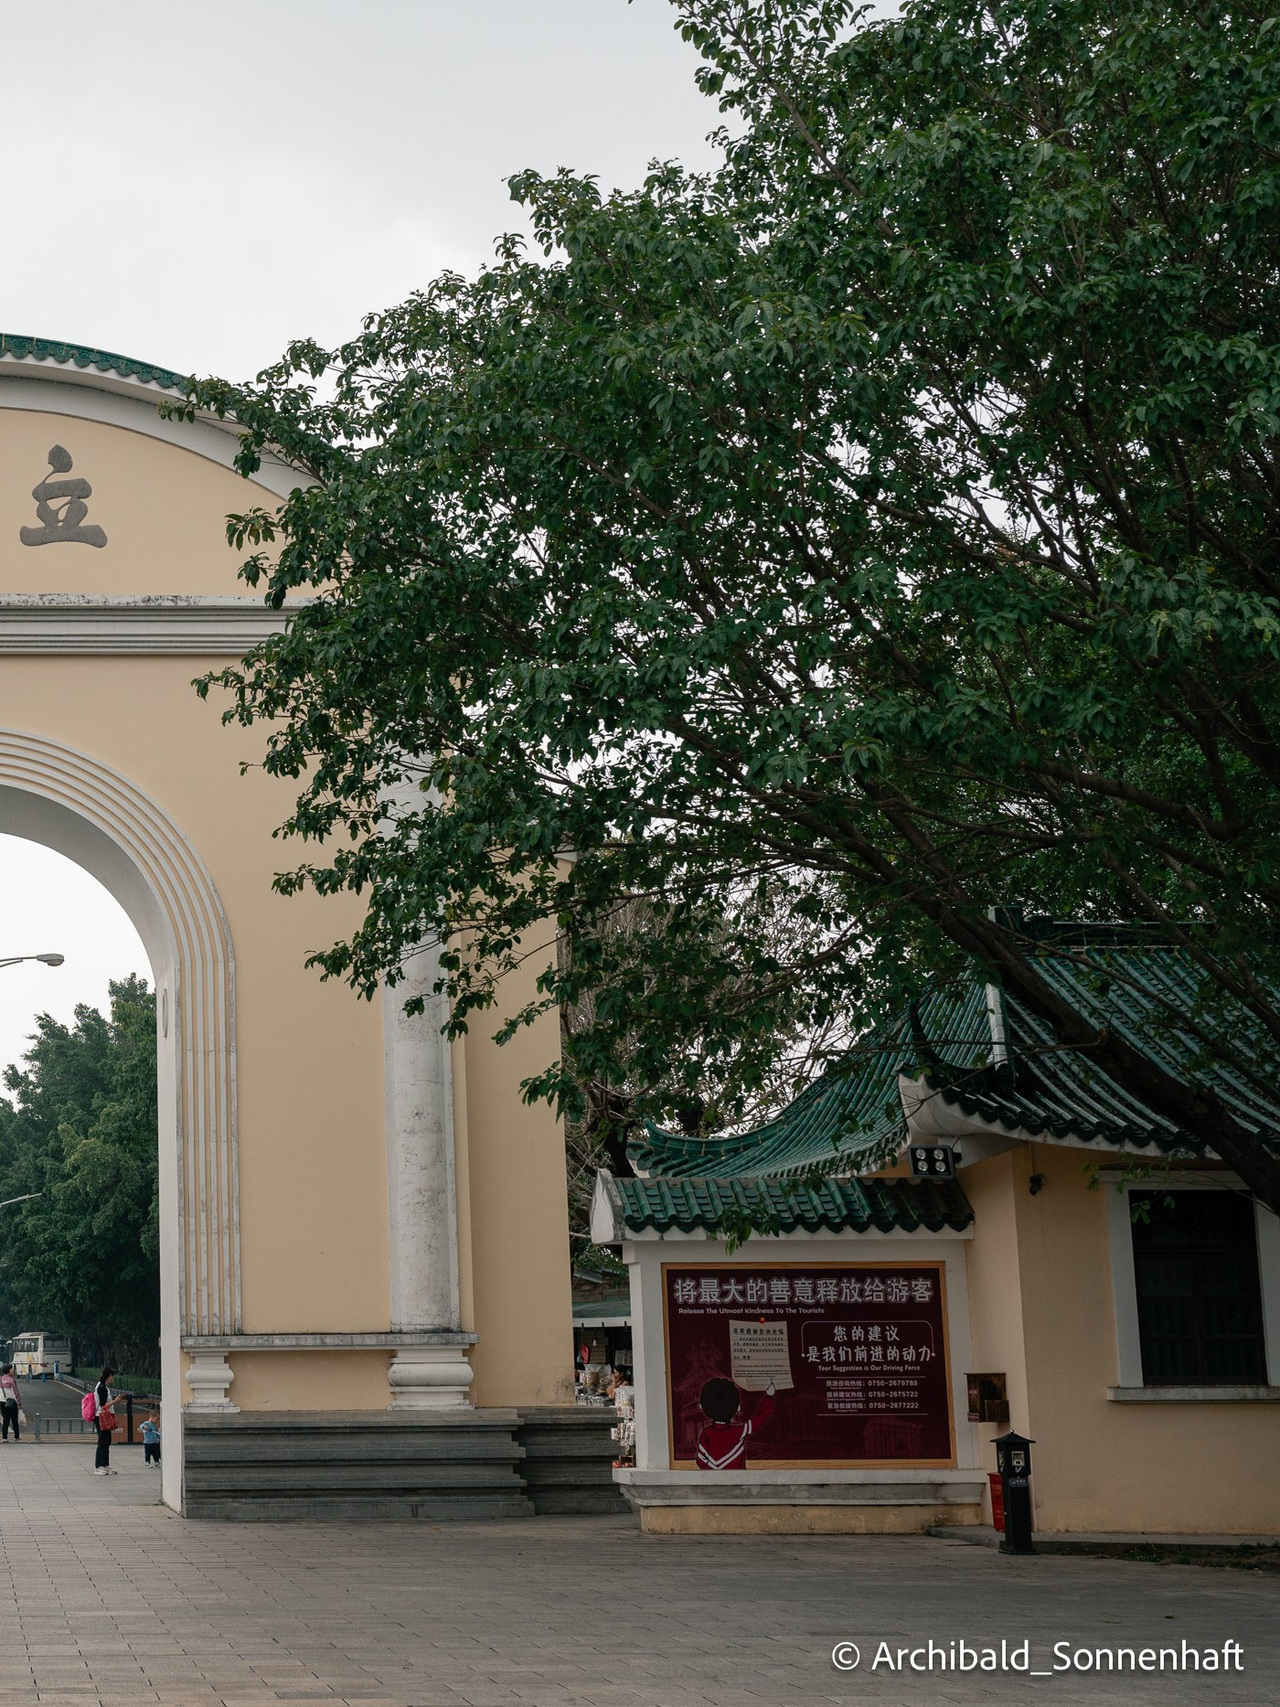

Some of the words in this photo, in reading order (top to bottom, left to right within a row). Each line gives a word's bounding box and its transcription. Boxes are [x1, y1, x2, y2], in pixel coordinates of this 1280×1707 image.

[675, 1278, 933, 1303] 将最大的善意释放给游客
[833, 1325, 900, 1342] 您的建议
[806, 1345, 931, 1363] 是我们前进的动力
